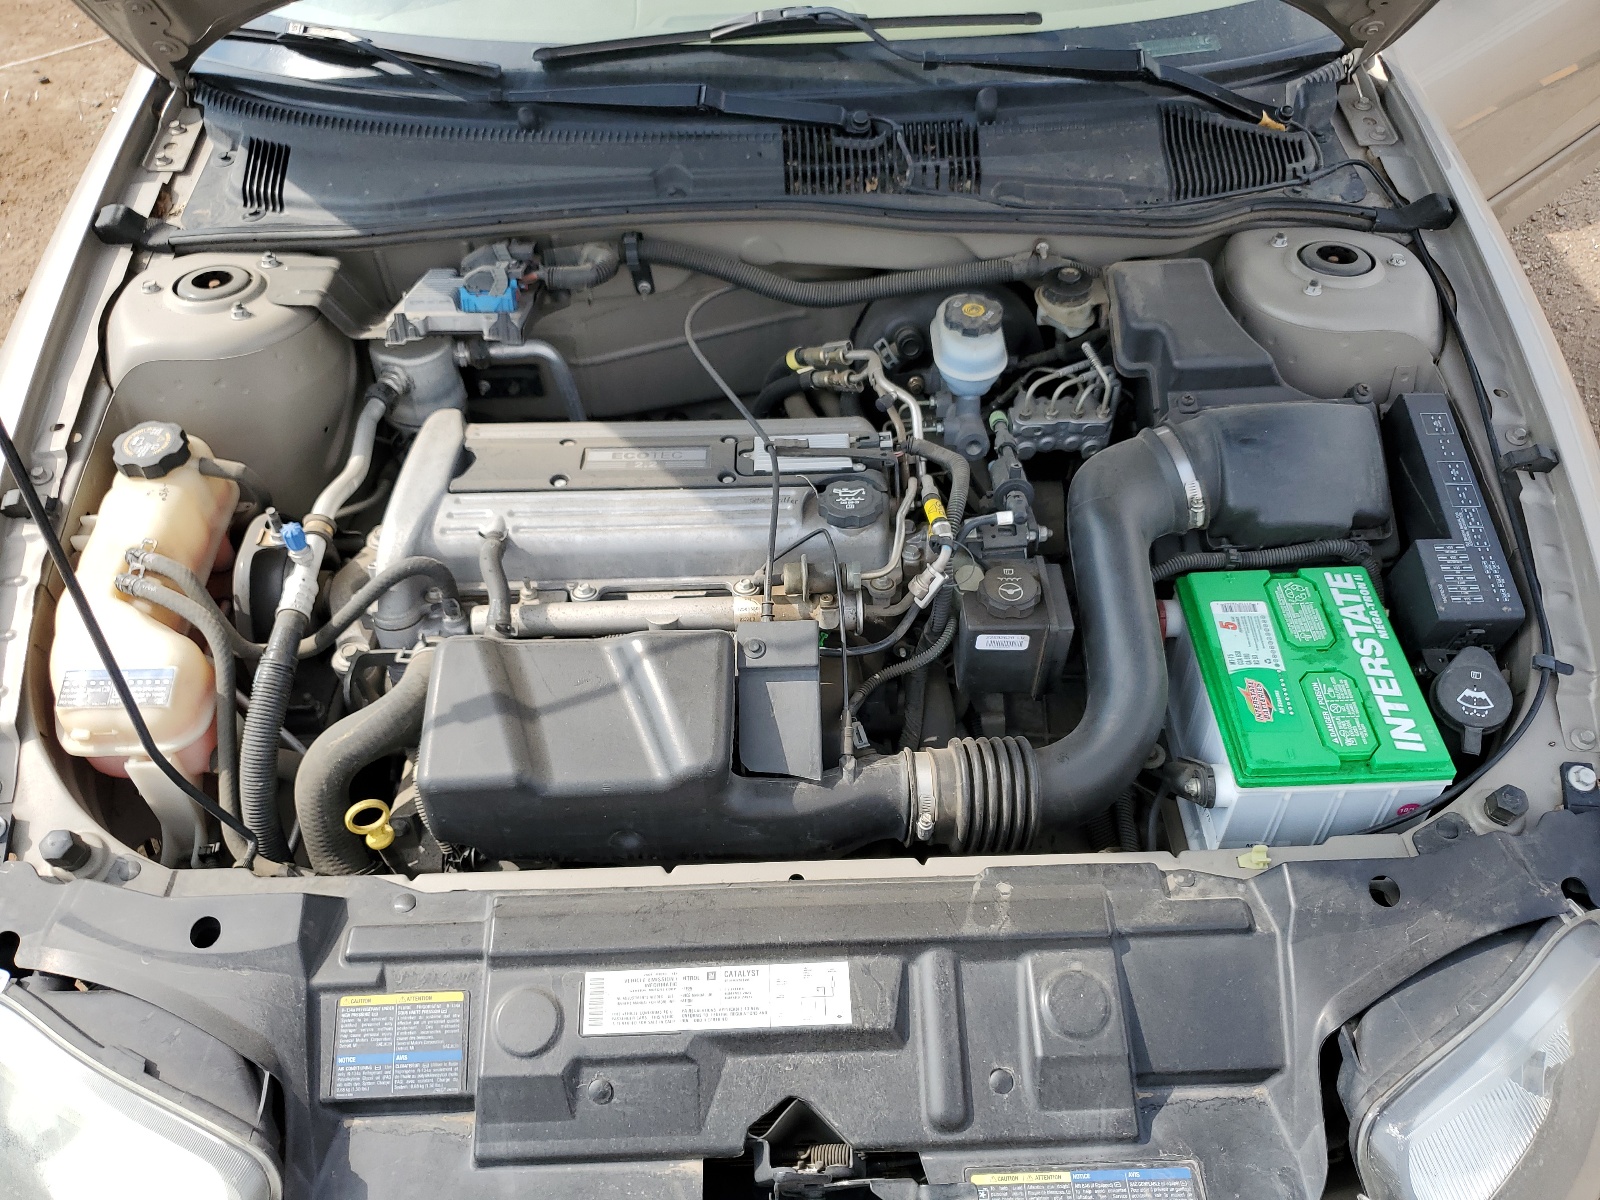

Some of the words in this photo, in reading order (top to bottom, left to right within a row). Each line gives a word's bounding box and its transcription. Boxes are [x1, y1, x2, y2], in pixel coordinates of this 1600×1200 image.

[612, 452, 683, 460] ECOTEC
[1356, 582, 1389, 639] MEGA-TRON
[1219, 620, 1237, 630] 5
[1324, 572, 1427, 752] INTERSTATE
[1248, 682, 1263, 720] INTERSTATE
[1312, 682, 1325, 705] POISON
[1322, 711, 1336, 737] DANGER
